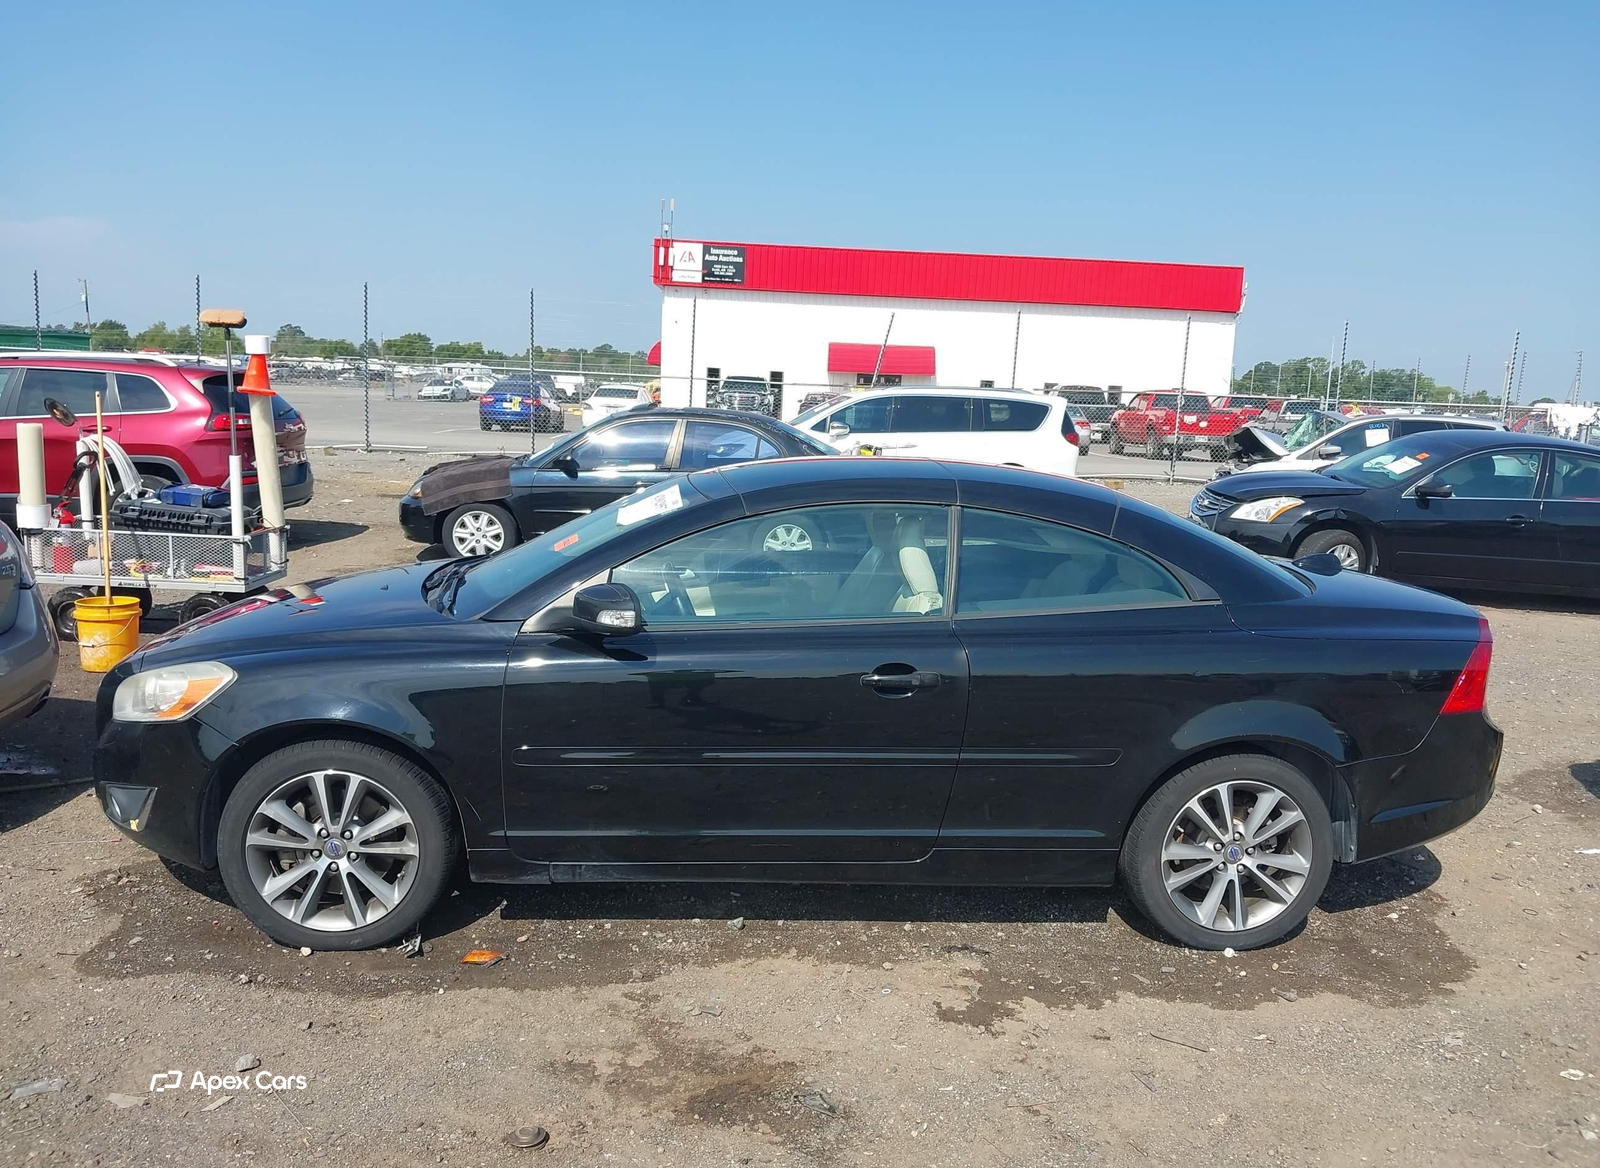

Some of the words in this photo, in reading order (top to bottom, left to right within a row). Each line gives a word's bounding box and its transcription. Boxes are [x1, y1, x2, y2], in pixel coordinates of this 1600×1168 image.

[710, 247, 738, 255] Insurance
[704, 253, 718, 261] Auto
[718, 254, 743, 263] Auctions
